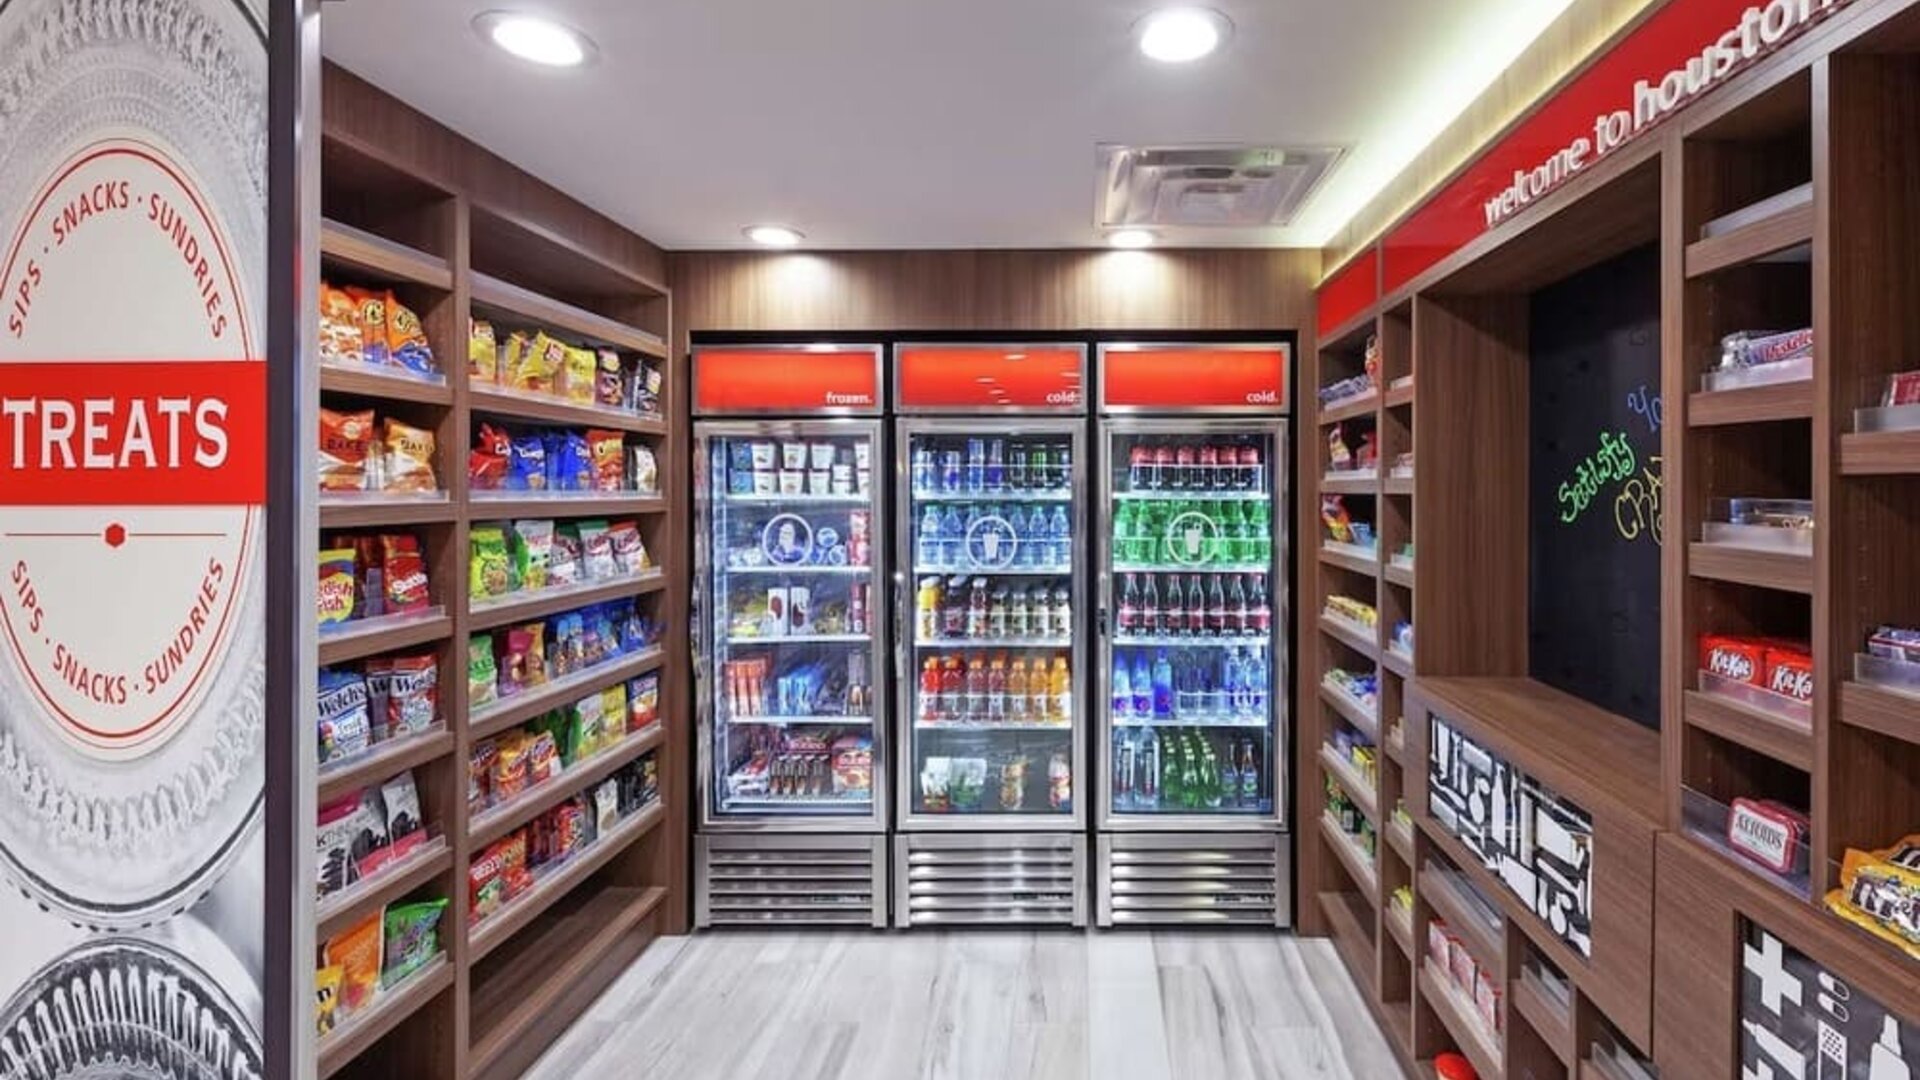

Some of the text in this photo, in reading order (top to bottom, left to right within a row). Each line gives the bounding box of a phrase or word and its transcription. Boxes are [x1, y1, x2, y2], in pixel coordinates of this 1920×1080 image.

[1484, 137, 1591, 226] welcome
[1593, 110, 1632, 155] to
[8, 181, 228, 339] SIPS SNACKS SUNDRIES
[3, 395, 229, 469] TREATS
[825, 391, 873, 405] frozen.
[1558, 431, 1636, 523] Satisfy
[11, 557, 225, 705] SIPS SNACKS SUNDRIES
[1771, 664, 1813, 699] KitKa
